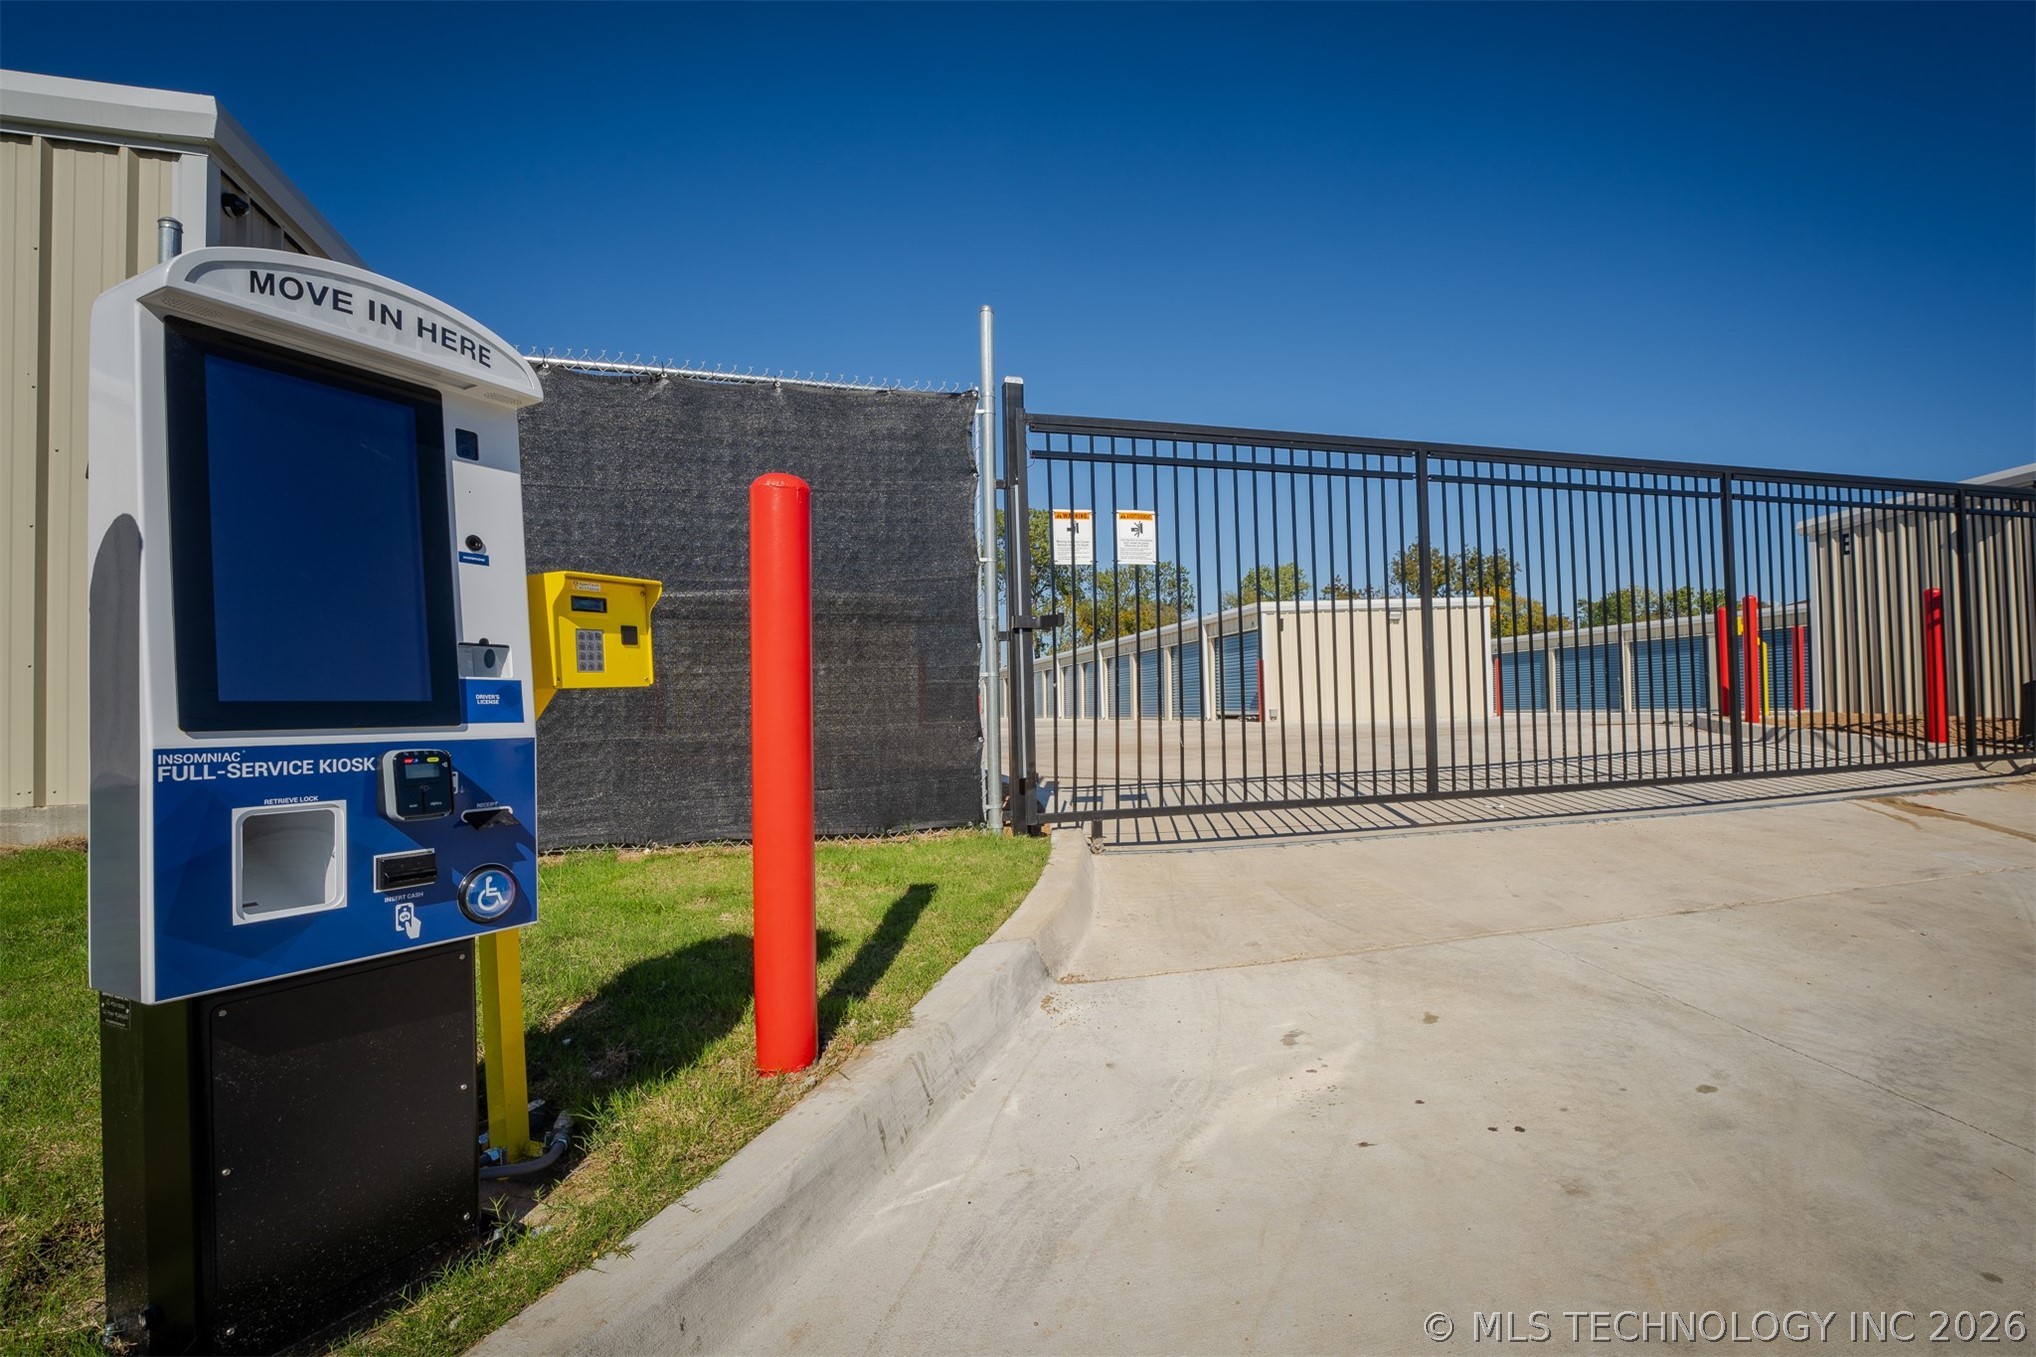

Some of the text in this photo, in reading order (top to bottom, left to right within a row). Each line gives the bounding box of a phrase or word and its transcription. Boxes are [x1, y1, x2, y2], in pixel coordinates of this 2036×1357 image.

[250, 270, 492, 369] MOVE IN HERE
[157, 752, 241, 765] INSOMNIAC
[157, 757, 376, 783] FULL-SERVICE KIOSK
[263, 795, 319, 805] RETRIEVE LOCK
[384, 891, 424, 903] INSERT CASH
